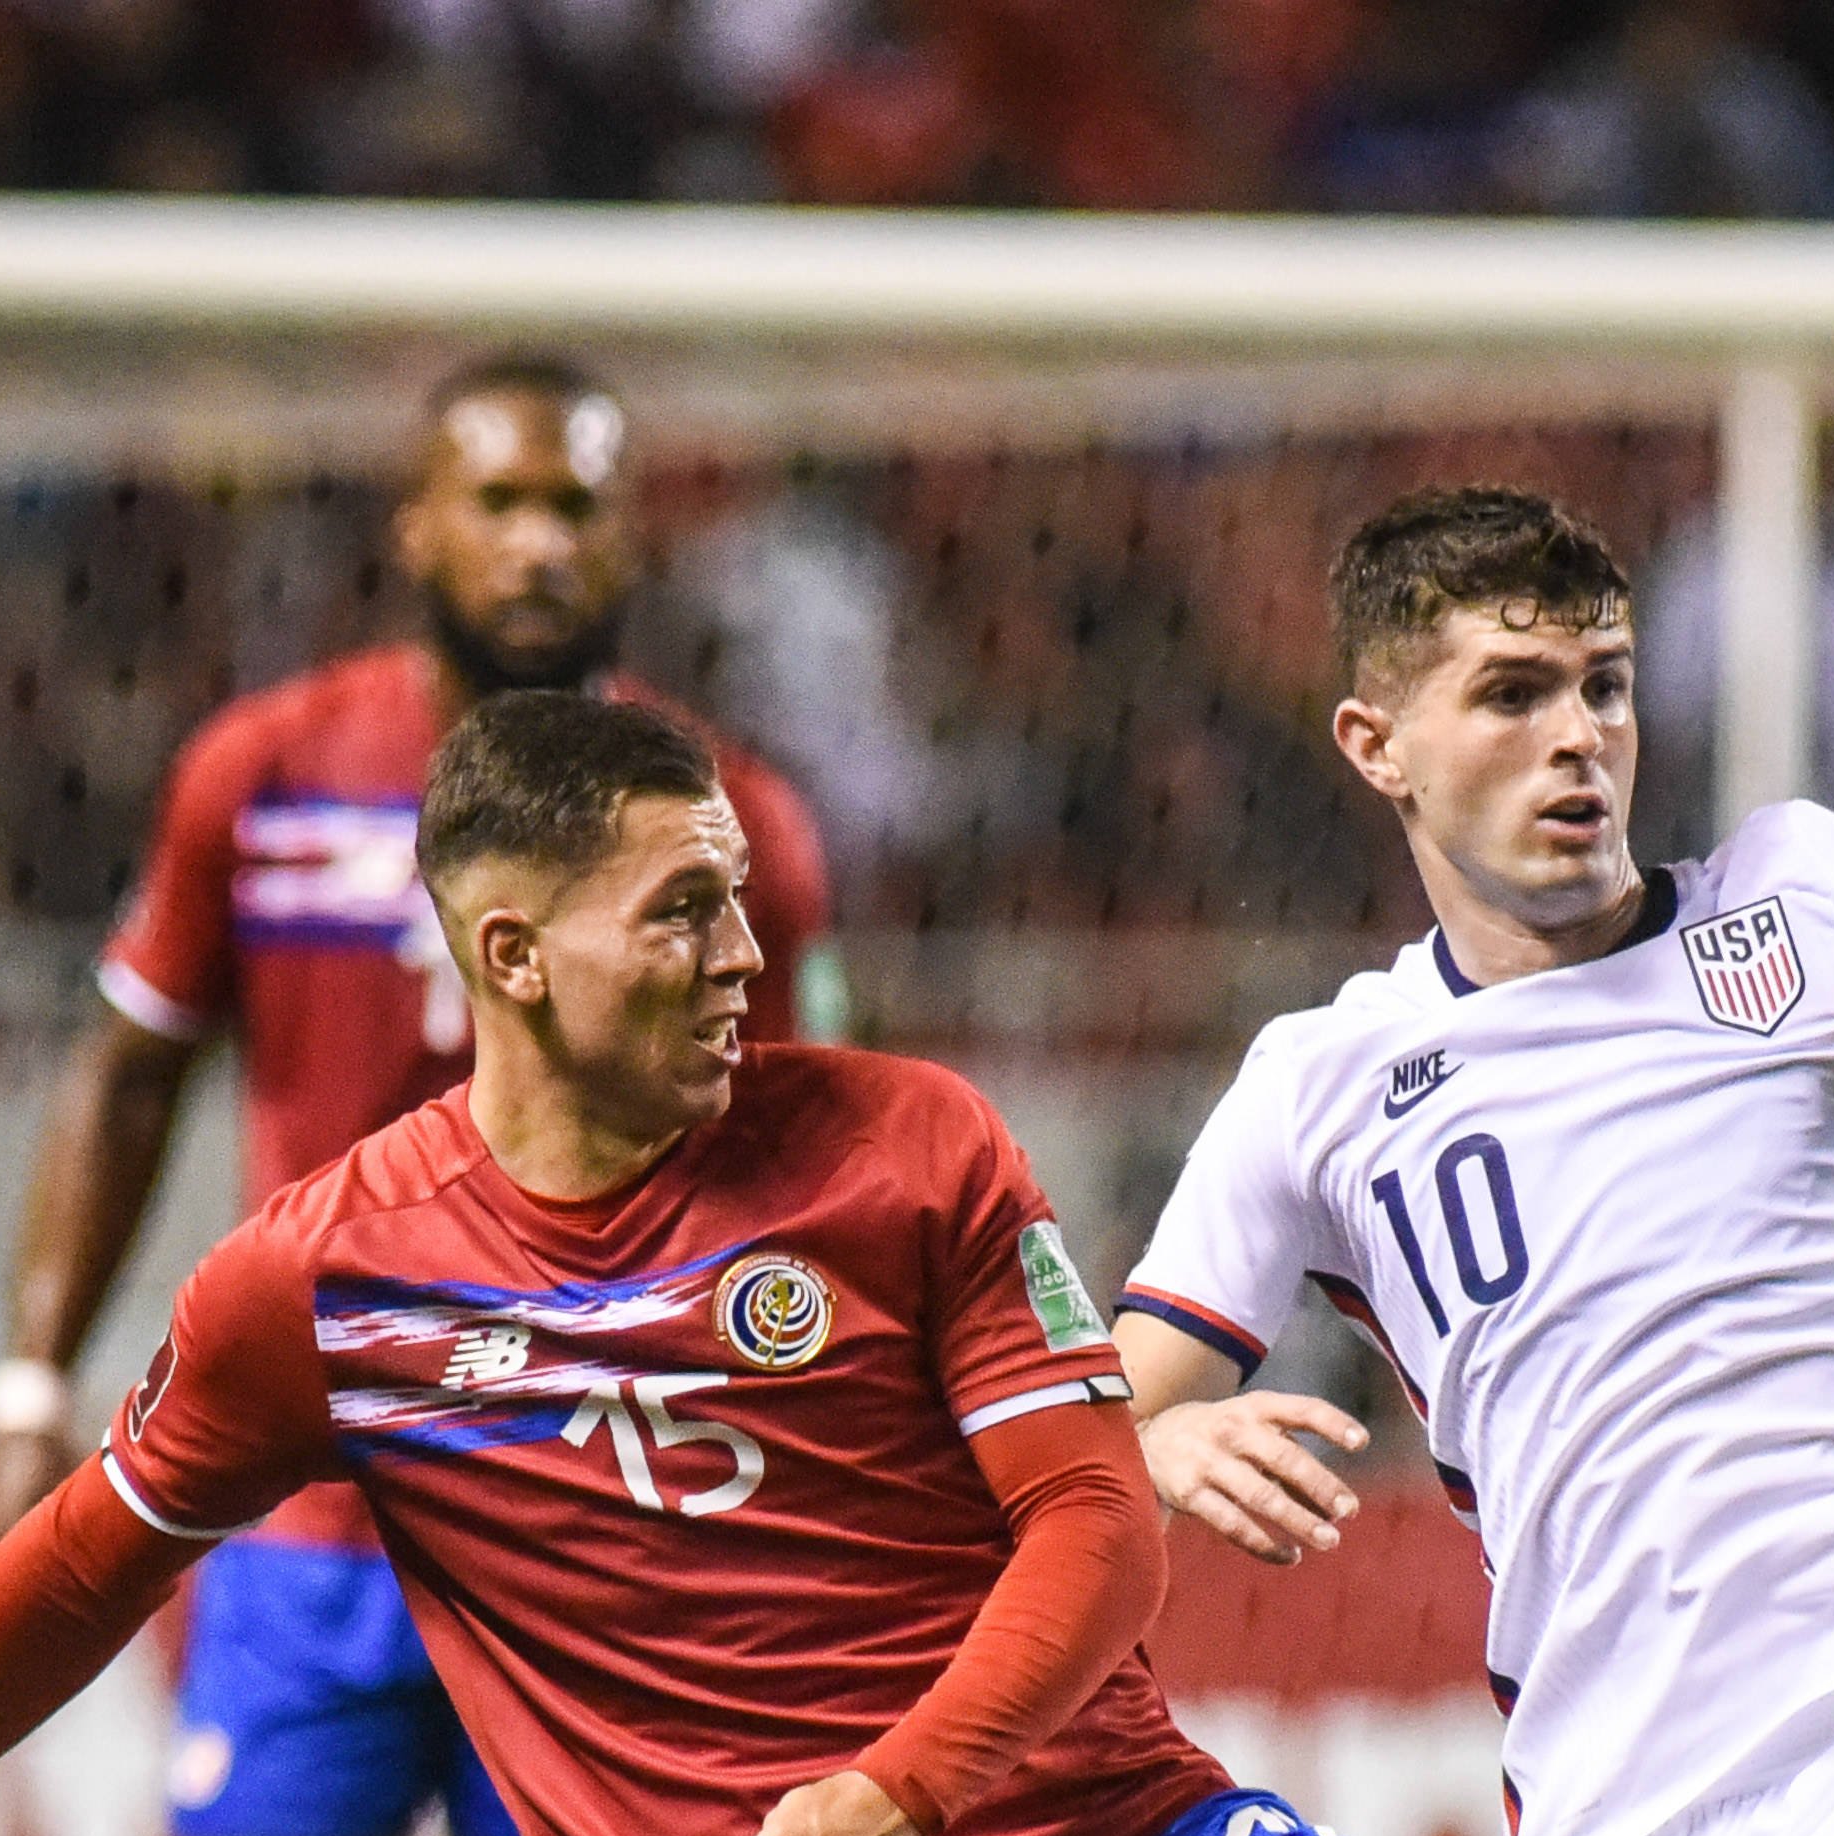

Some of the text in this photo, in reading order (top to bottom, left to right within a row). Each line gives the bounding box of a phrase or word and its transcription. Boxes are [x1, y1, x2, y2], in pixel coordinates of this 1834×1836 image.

[1692, 907, 1779, 964] USA
[1391, 1048, 1448, 1097] NIKE
[1370, 1131, 1530, 1341] 10
[559, 1372, 766, 1518] 15
